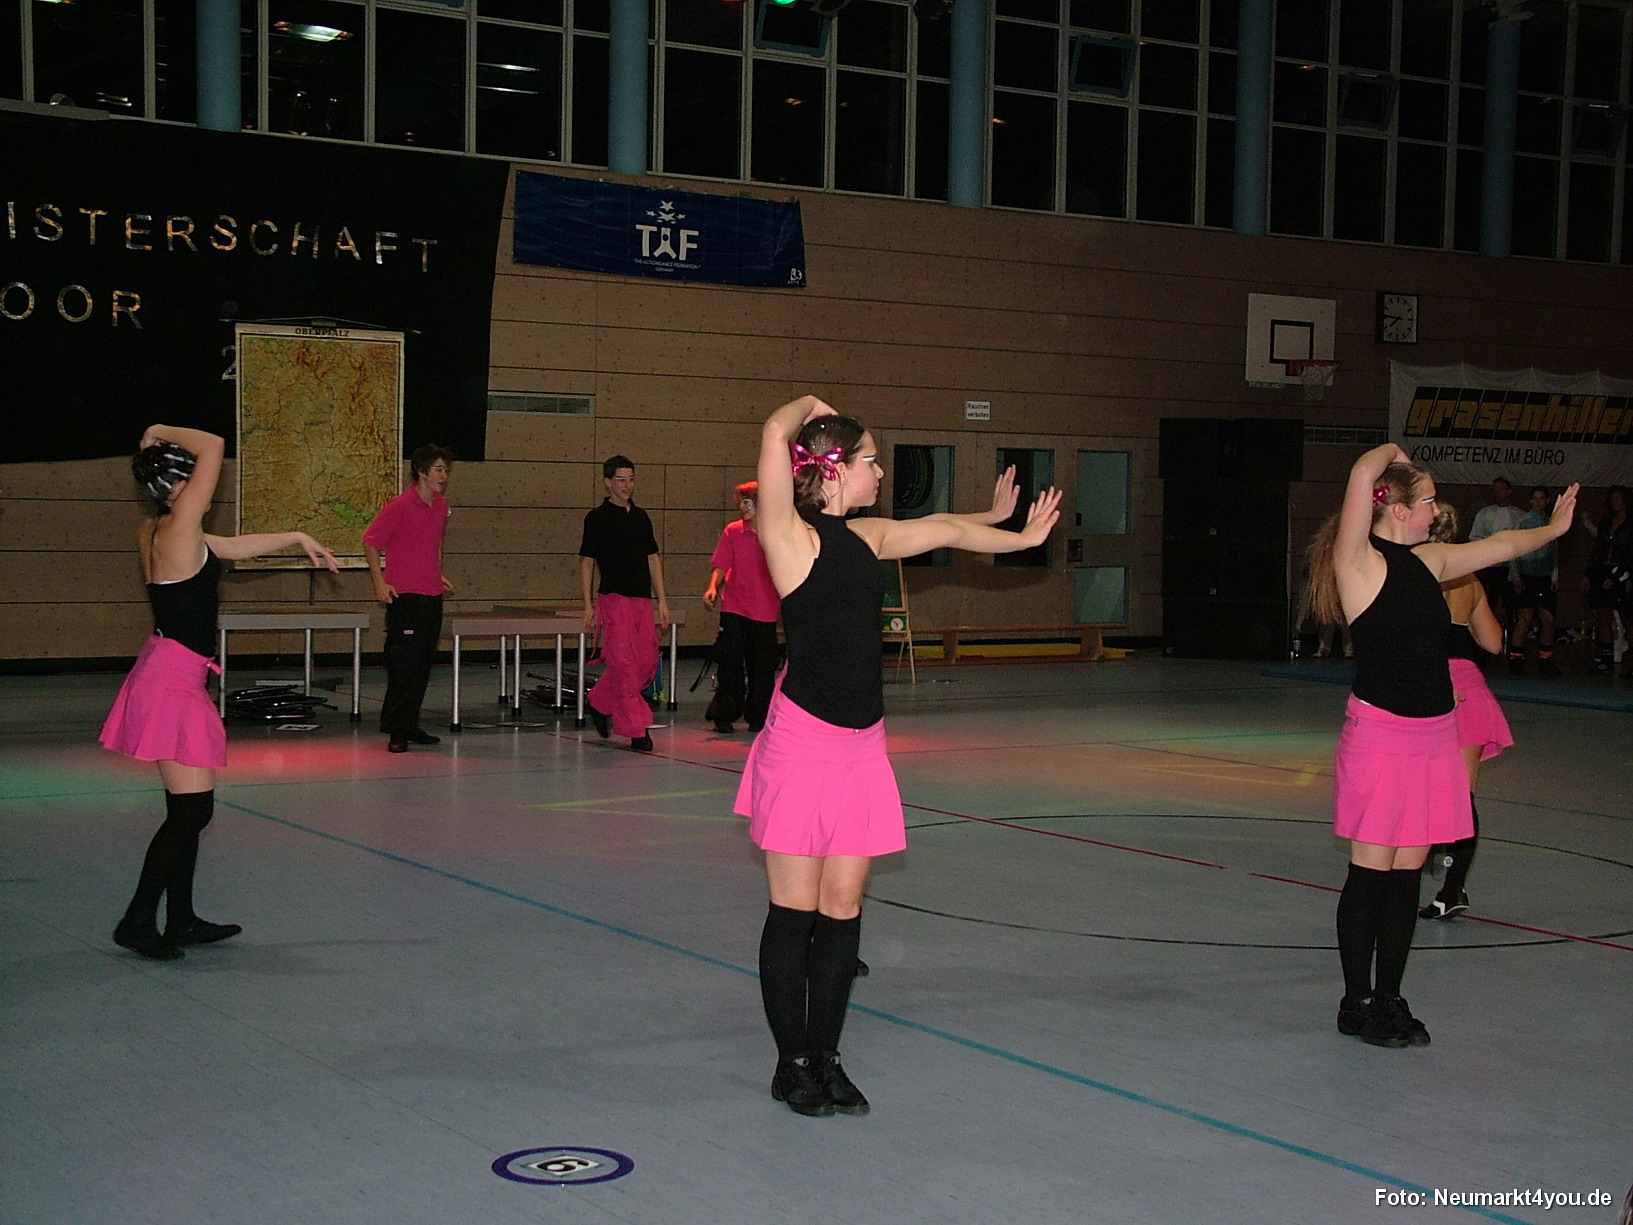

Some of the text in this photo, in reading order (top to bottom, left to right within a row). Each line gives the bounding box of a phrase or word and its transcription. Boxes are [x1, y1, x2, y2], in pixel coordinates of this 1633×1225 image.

[7, 200, 438, 273] ISTERSCHAFT
[0, 281, 144, 330] OOR
[295, 327, 350, 337] OBERPFALZ
[1411, 445, 1565, 466] KOMPETENZ IM BÜRO
